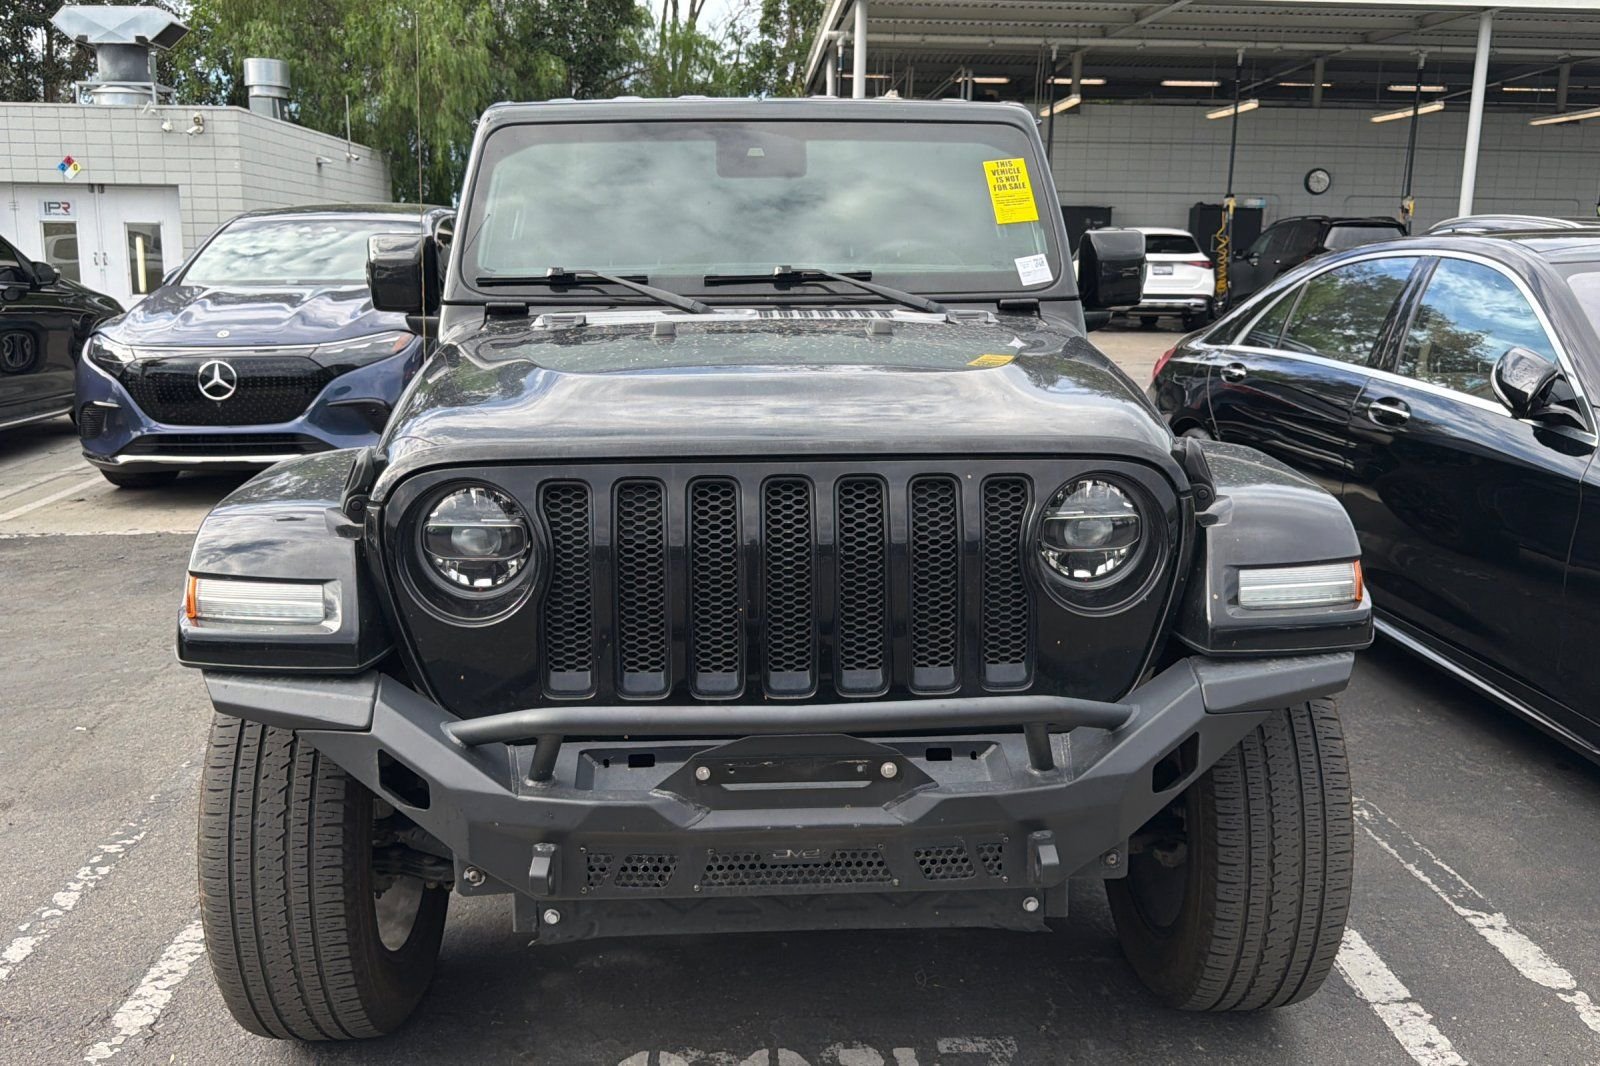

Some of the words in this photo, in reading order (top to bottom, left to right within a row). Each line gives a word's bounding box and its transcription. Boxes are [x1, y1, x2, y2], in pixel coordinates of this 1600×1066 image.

[991, 168, 1021, 176] VEHICLE
[993, 183, 1008, 191] FOR
[1009, 182, 1027, 190] SALE
[44, 201, 70, 213] IPR
